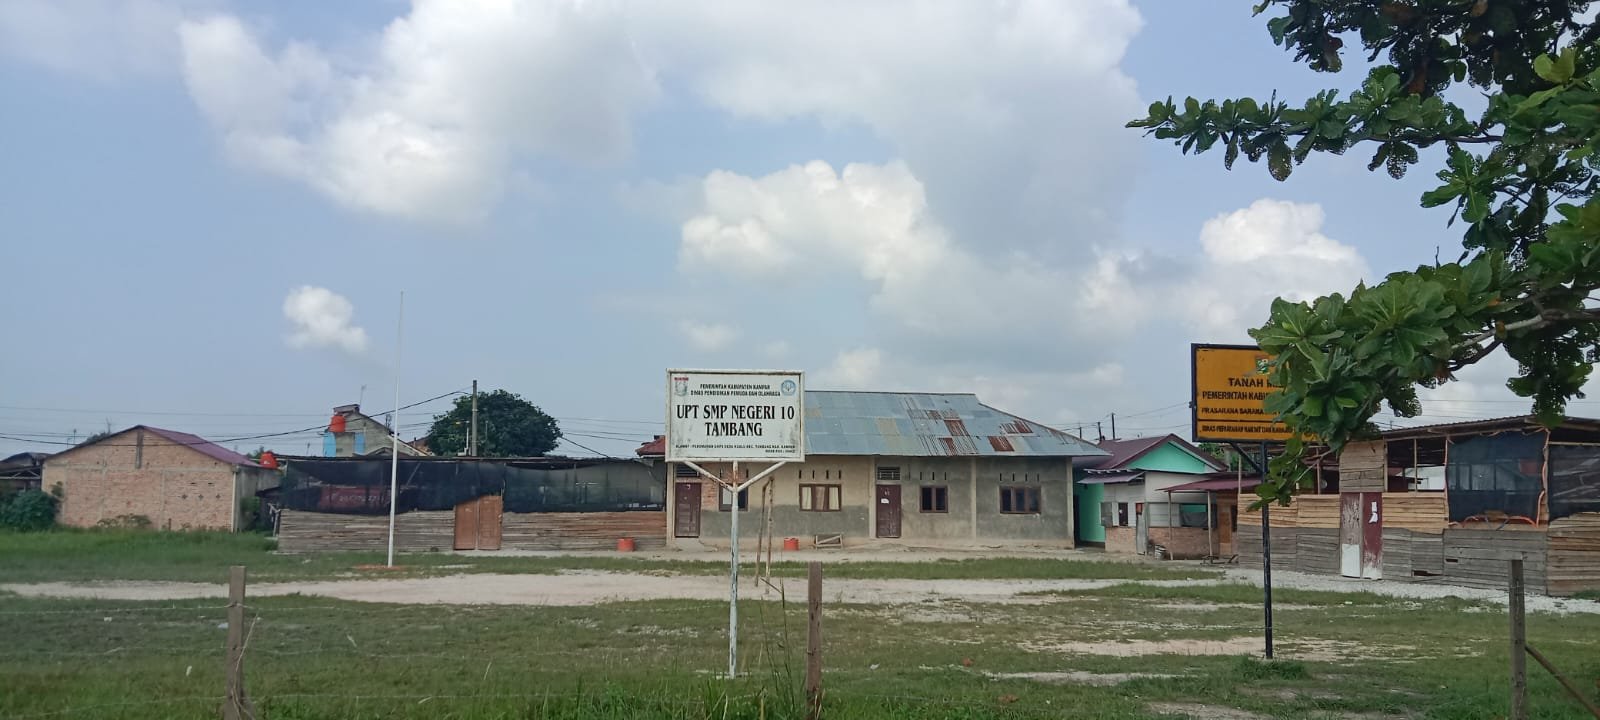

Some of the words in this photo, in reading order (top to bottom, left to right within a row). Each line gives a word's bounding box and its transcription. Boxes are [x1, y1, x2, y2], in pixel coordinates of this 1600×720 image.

[1228, 378, 1264, 388] TANAH
[1202, 391, 1247, 400] PEMERINTAH
[677, 405, 699, 418] UPT
[703, 405, 727, 419] SMP
[731, 405, 775, 419] NEGERI
[781, 406, 794, 419] 10
[705, 422, 763, 436] TAMBANG
